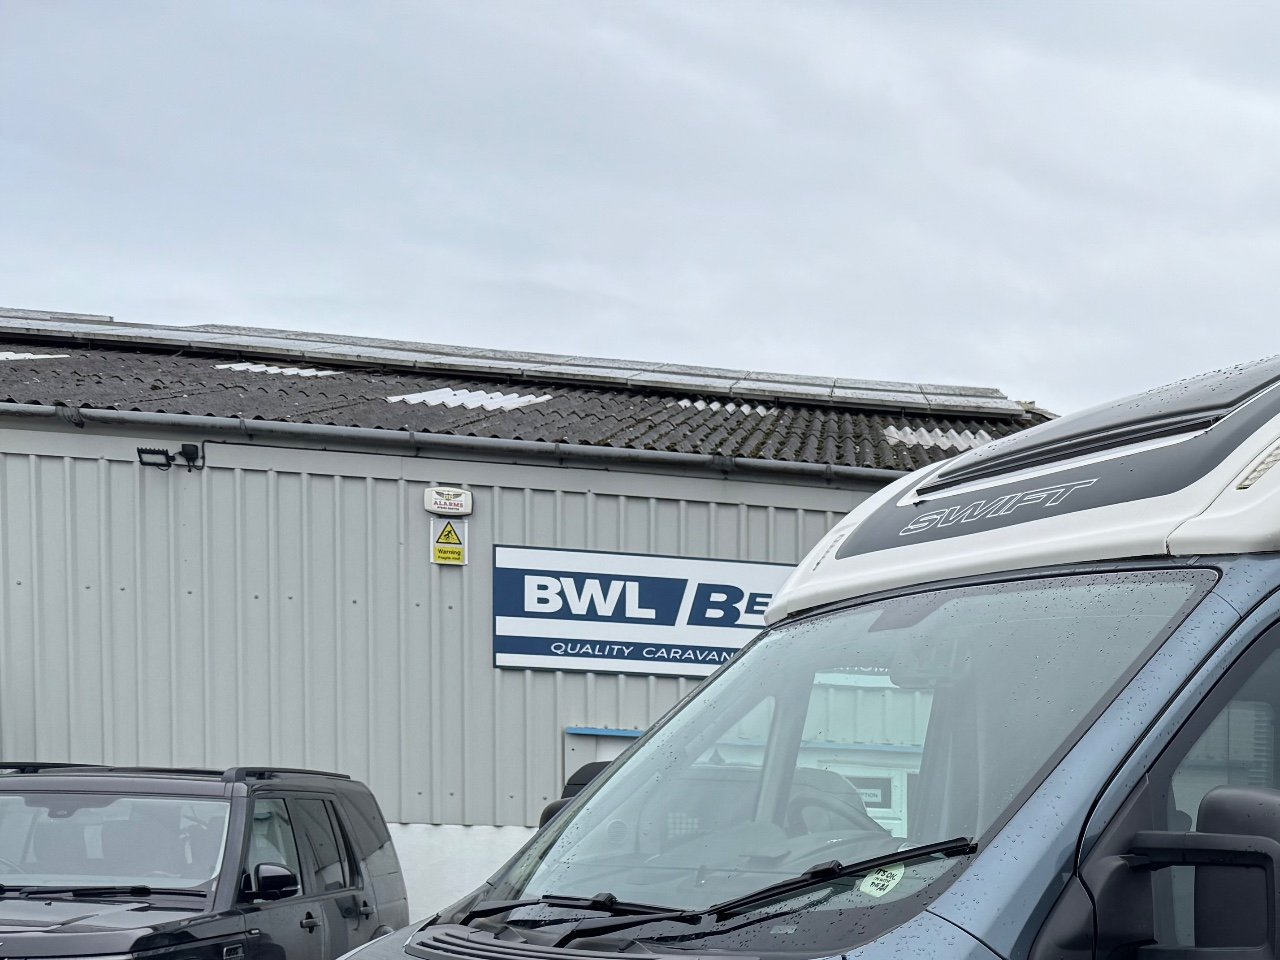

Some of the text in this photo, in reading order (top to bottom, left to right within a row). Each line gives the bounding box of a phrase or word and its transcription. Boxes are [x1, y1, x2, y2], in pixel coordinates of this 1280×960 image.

[433, 500, 464, 508] ALARMS
[899, 477, 1101, 536] SWIFT
[437, 548, 461, 556] Warning
[524, 575, 656, 620] BWL
[551, 642, 634, 657] QUALITY
